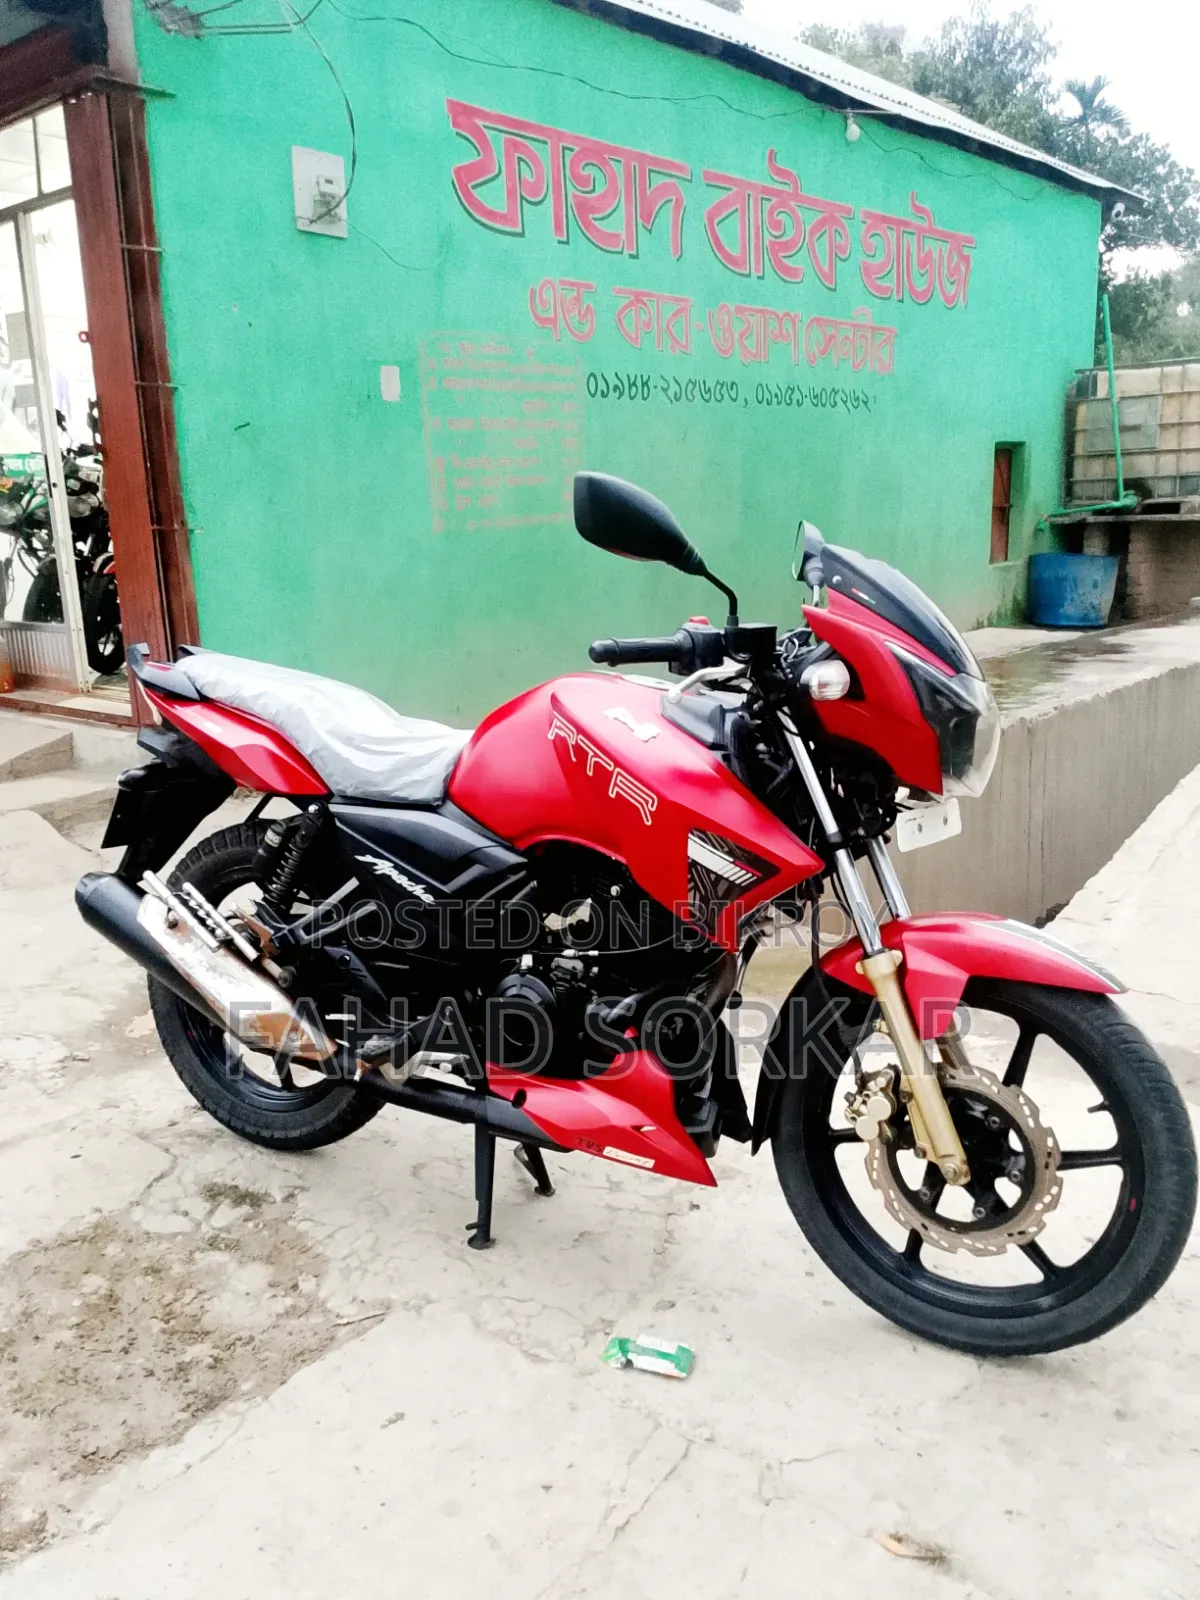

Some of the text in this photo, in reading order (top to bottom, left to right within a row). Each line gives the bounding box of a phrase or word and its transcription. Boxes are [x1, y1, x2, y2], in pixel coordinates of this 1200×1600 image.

[445, 97, 977, 309] ফাহাদ বাইক হাউজ
[547, 710, 658, 826] RTR
